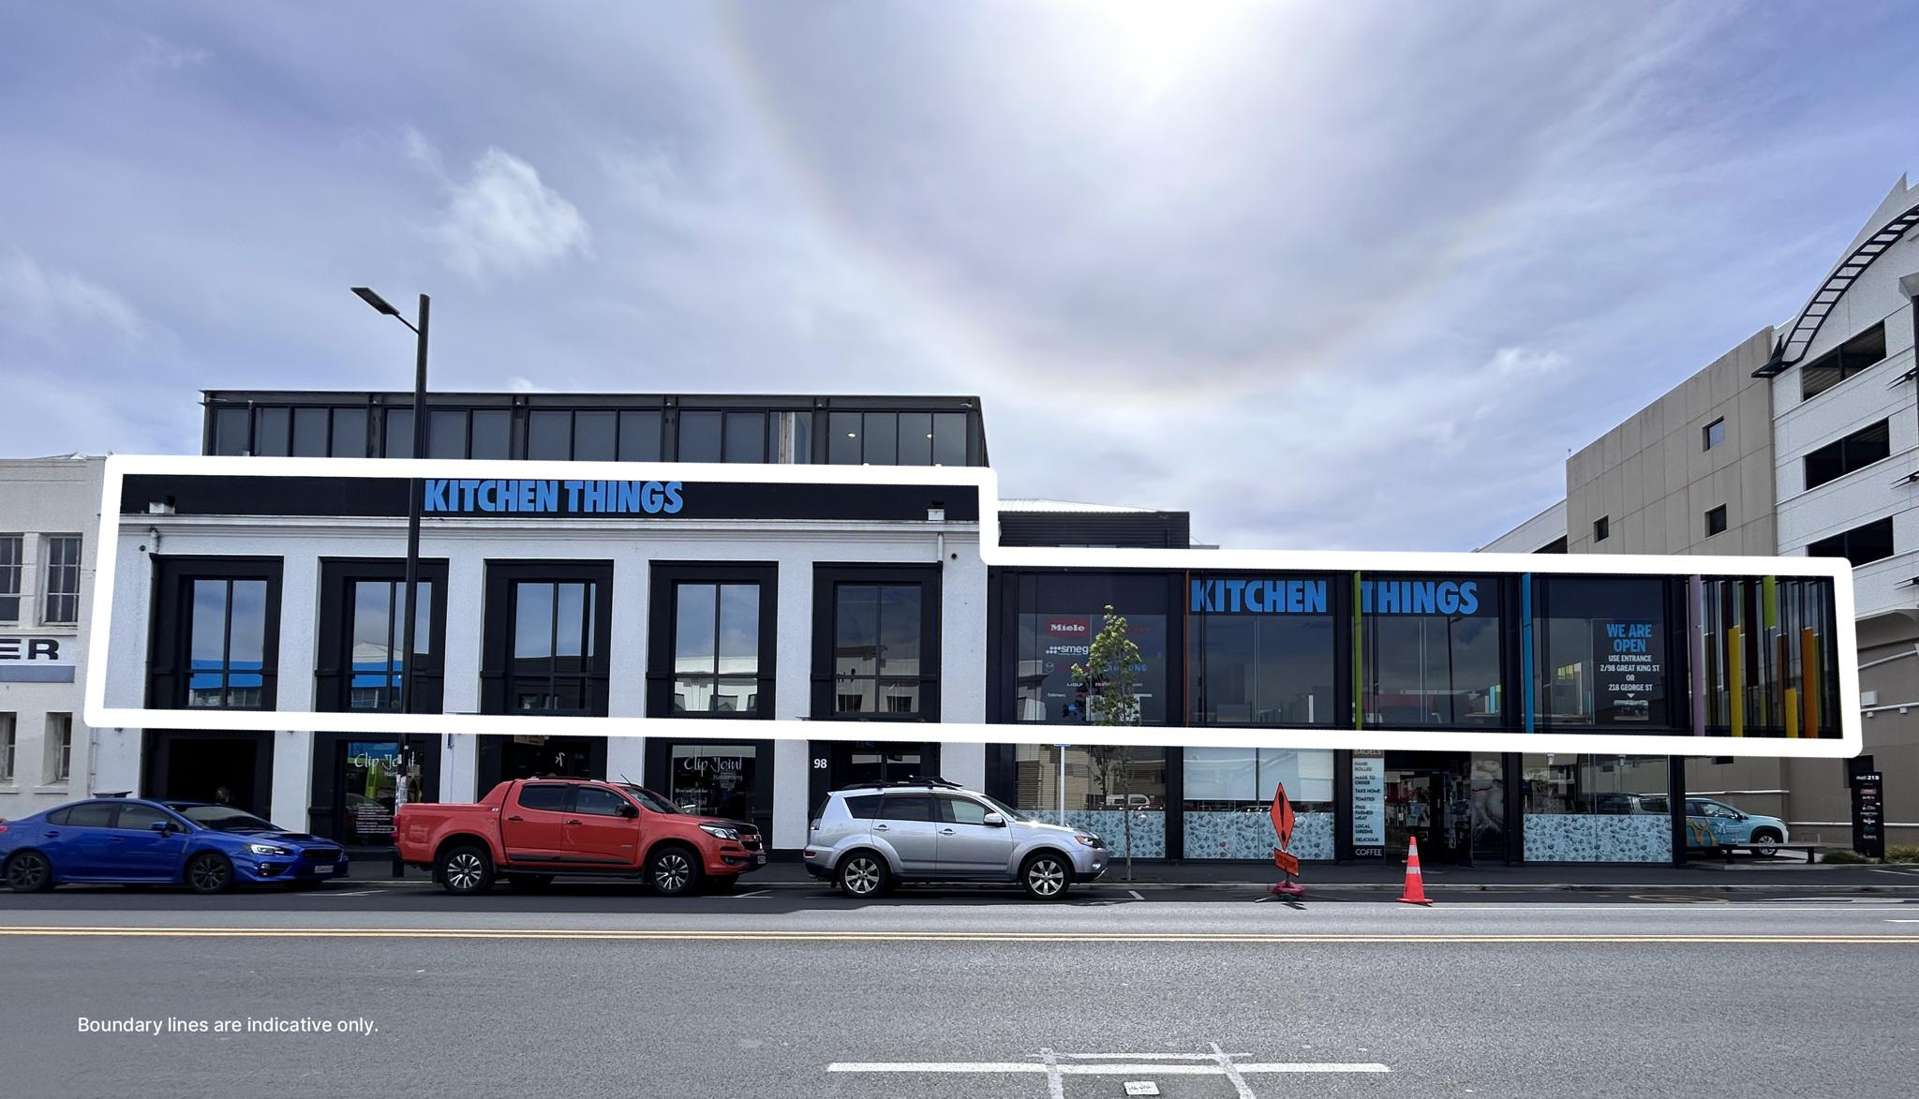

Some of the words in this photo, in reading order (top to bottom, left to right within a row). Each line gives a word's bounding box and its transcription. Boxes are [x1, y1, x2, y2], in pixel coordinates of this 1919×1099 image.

[424, 479, 559, 512] KITCHEN
[564, 480, 684, 513] THINGS
[1191, 579, 1327, 613] KITCHEN
[1361, 580, 1478, 615] THINGS
[1050, 623, 1085, 632] Miele
[1606, 623, 1626, 638] WE
[1628, 623, 1652, 638] ARE
[1061, 645, 1089, 655] smeg
[1613, 639, 1646, 653] OPEN
[1616, 664, 1635, 672] GREAT
[1636, 664, 1651, 672] KING
[1652, 664, 1660, 672] ST
[354, 752, 379, 775] Clip
[684, 753, 708, 777] Clip
[813, 758, 828, 769] 98
